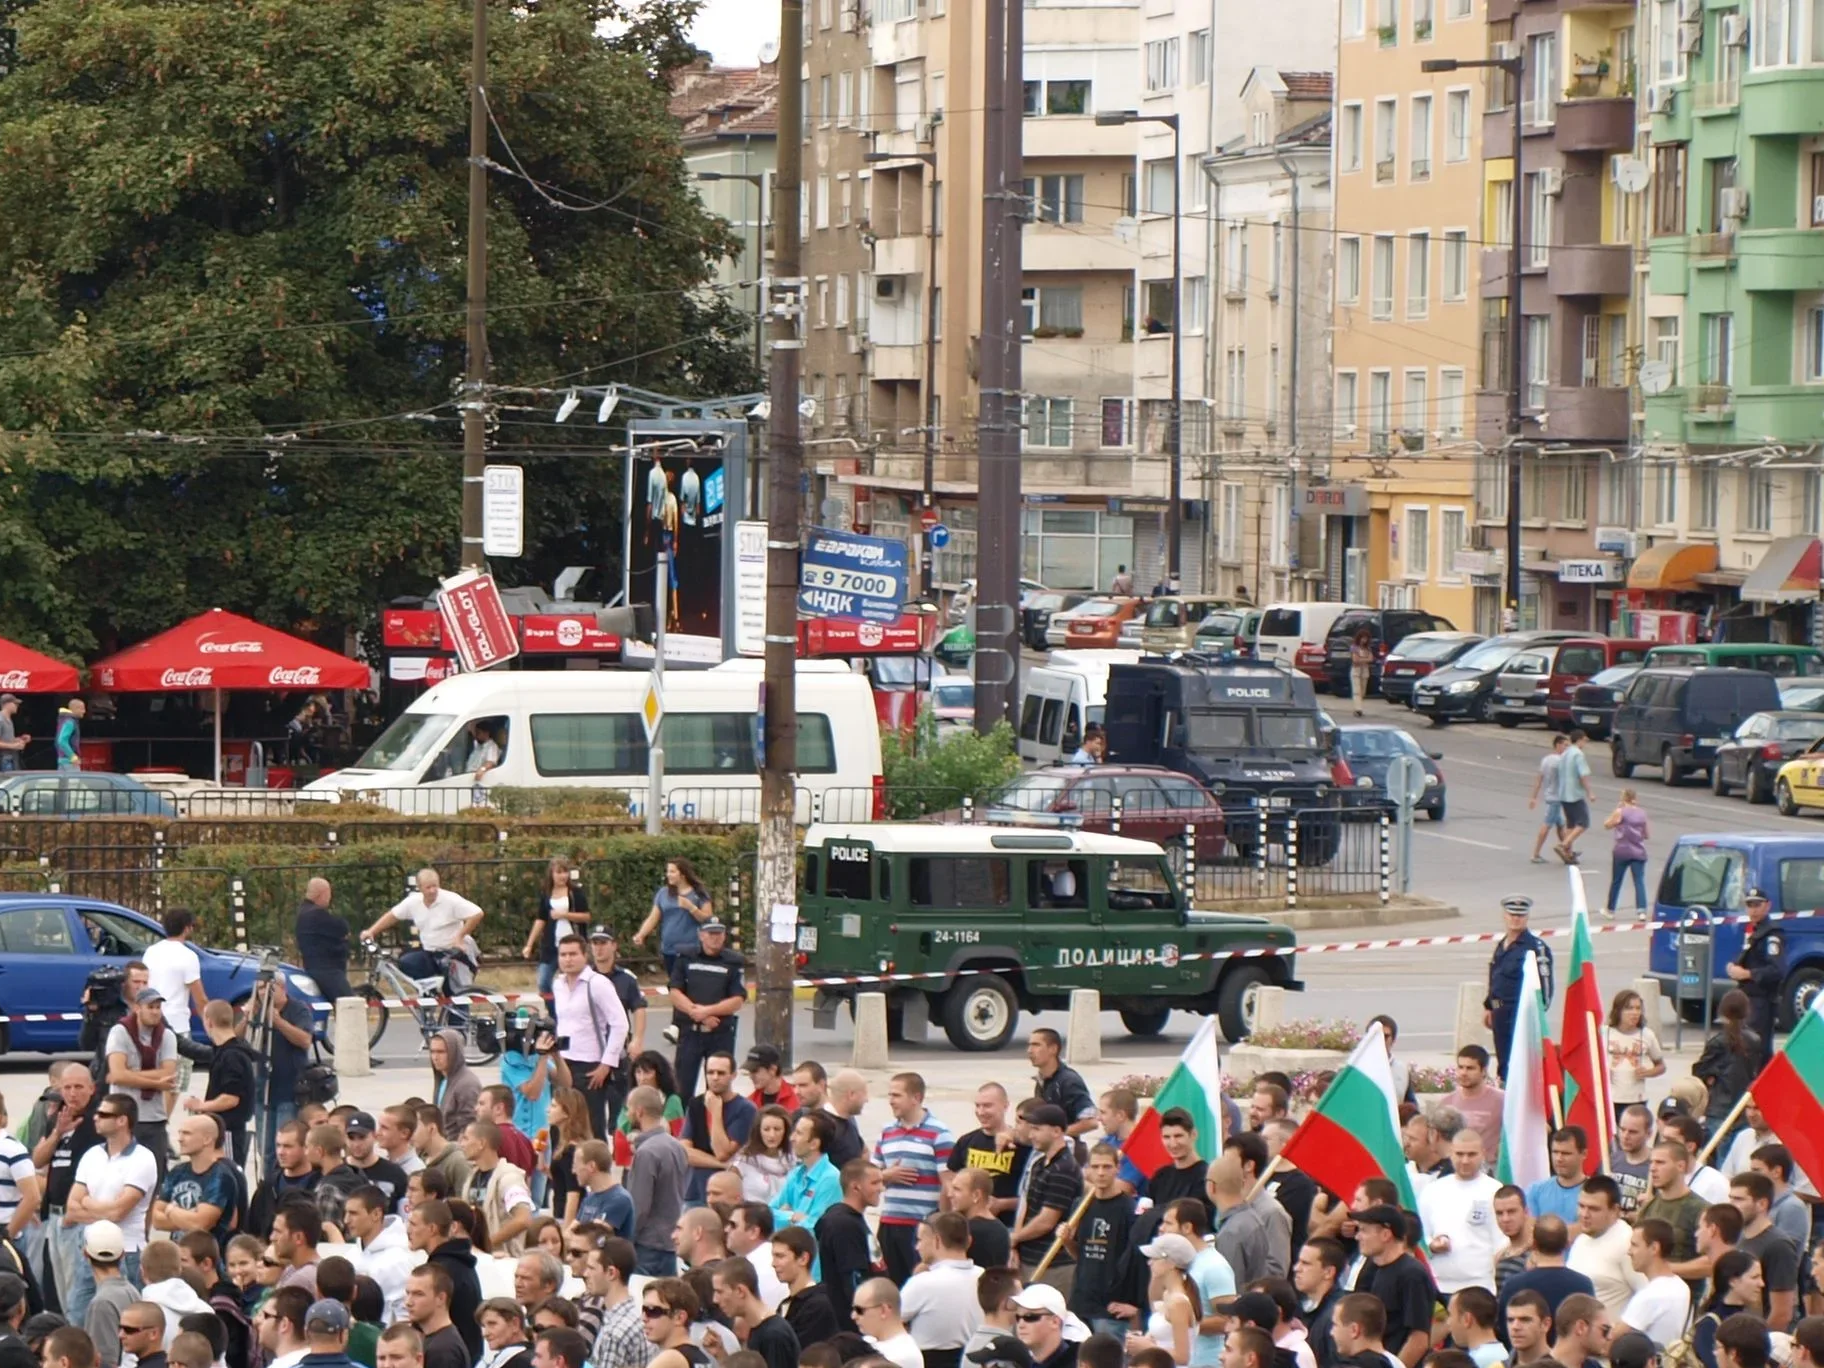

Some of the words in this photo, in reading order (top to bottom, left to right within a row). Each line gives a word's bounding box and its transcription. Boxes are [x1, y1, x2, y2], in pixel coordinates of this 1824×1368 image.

[488, 473, 518, 489] STIX
[822, 571, 834, 585] 9
[841, 573, 886, 594] 7000
[814, 589, 854, 614] НДК
[457, 590, 496, 662] POLYGLOT
[161, 667, 215, 687] Coca-Cola
[269, 666, 322, 685] Coca-Cola
[1227, 687, 1271, 698] POLICE
[831, 846, 869, 862] POLICE
[934, 930, 980, 943] 24-1164
[1059, 947, 1156, 967] ПОЛИЦИЯ
[967, 1148, 1015, 1173] EVERLAST
